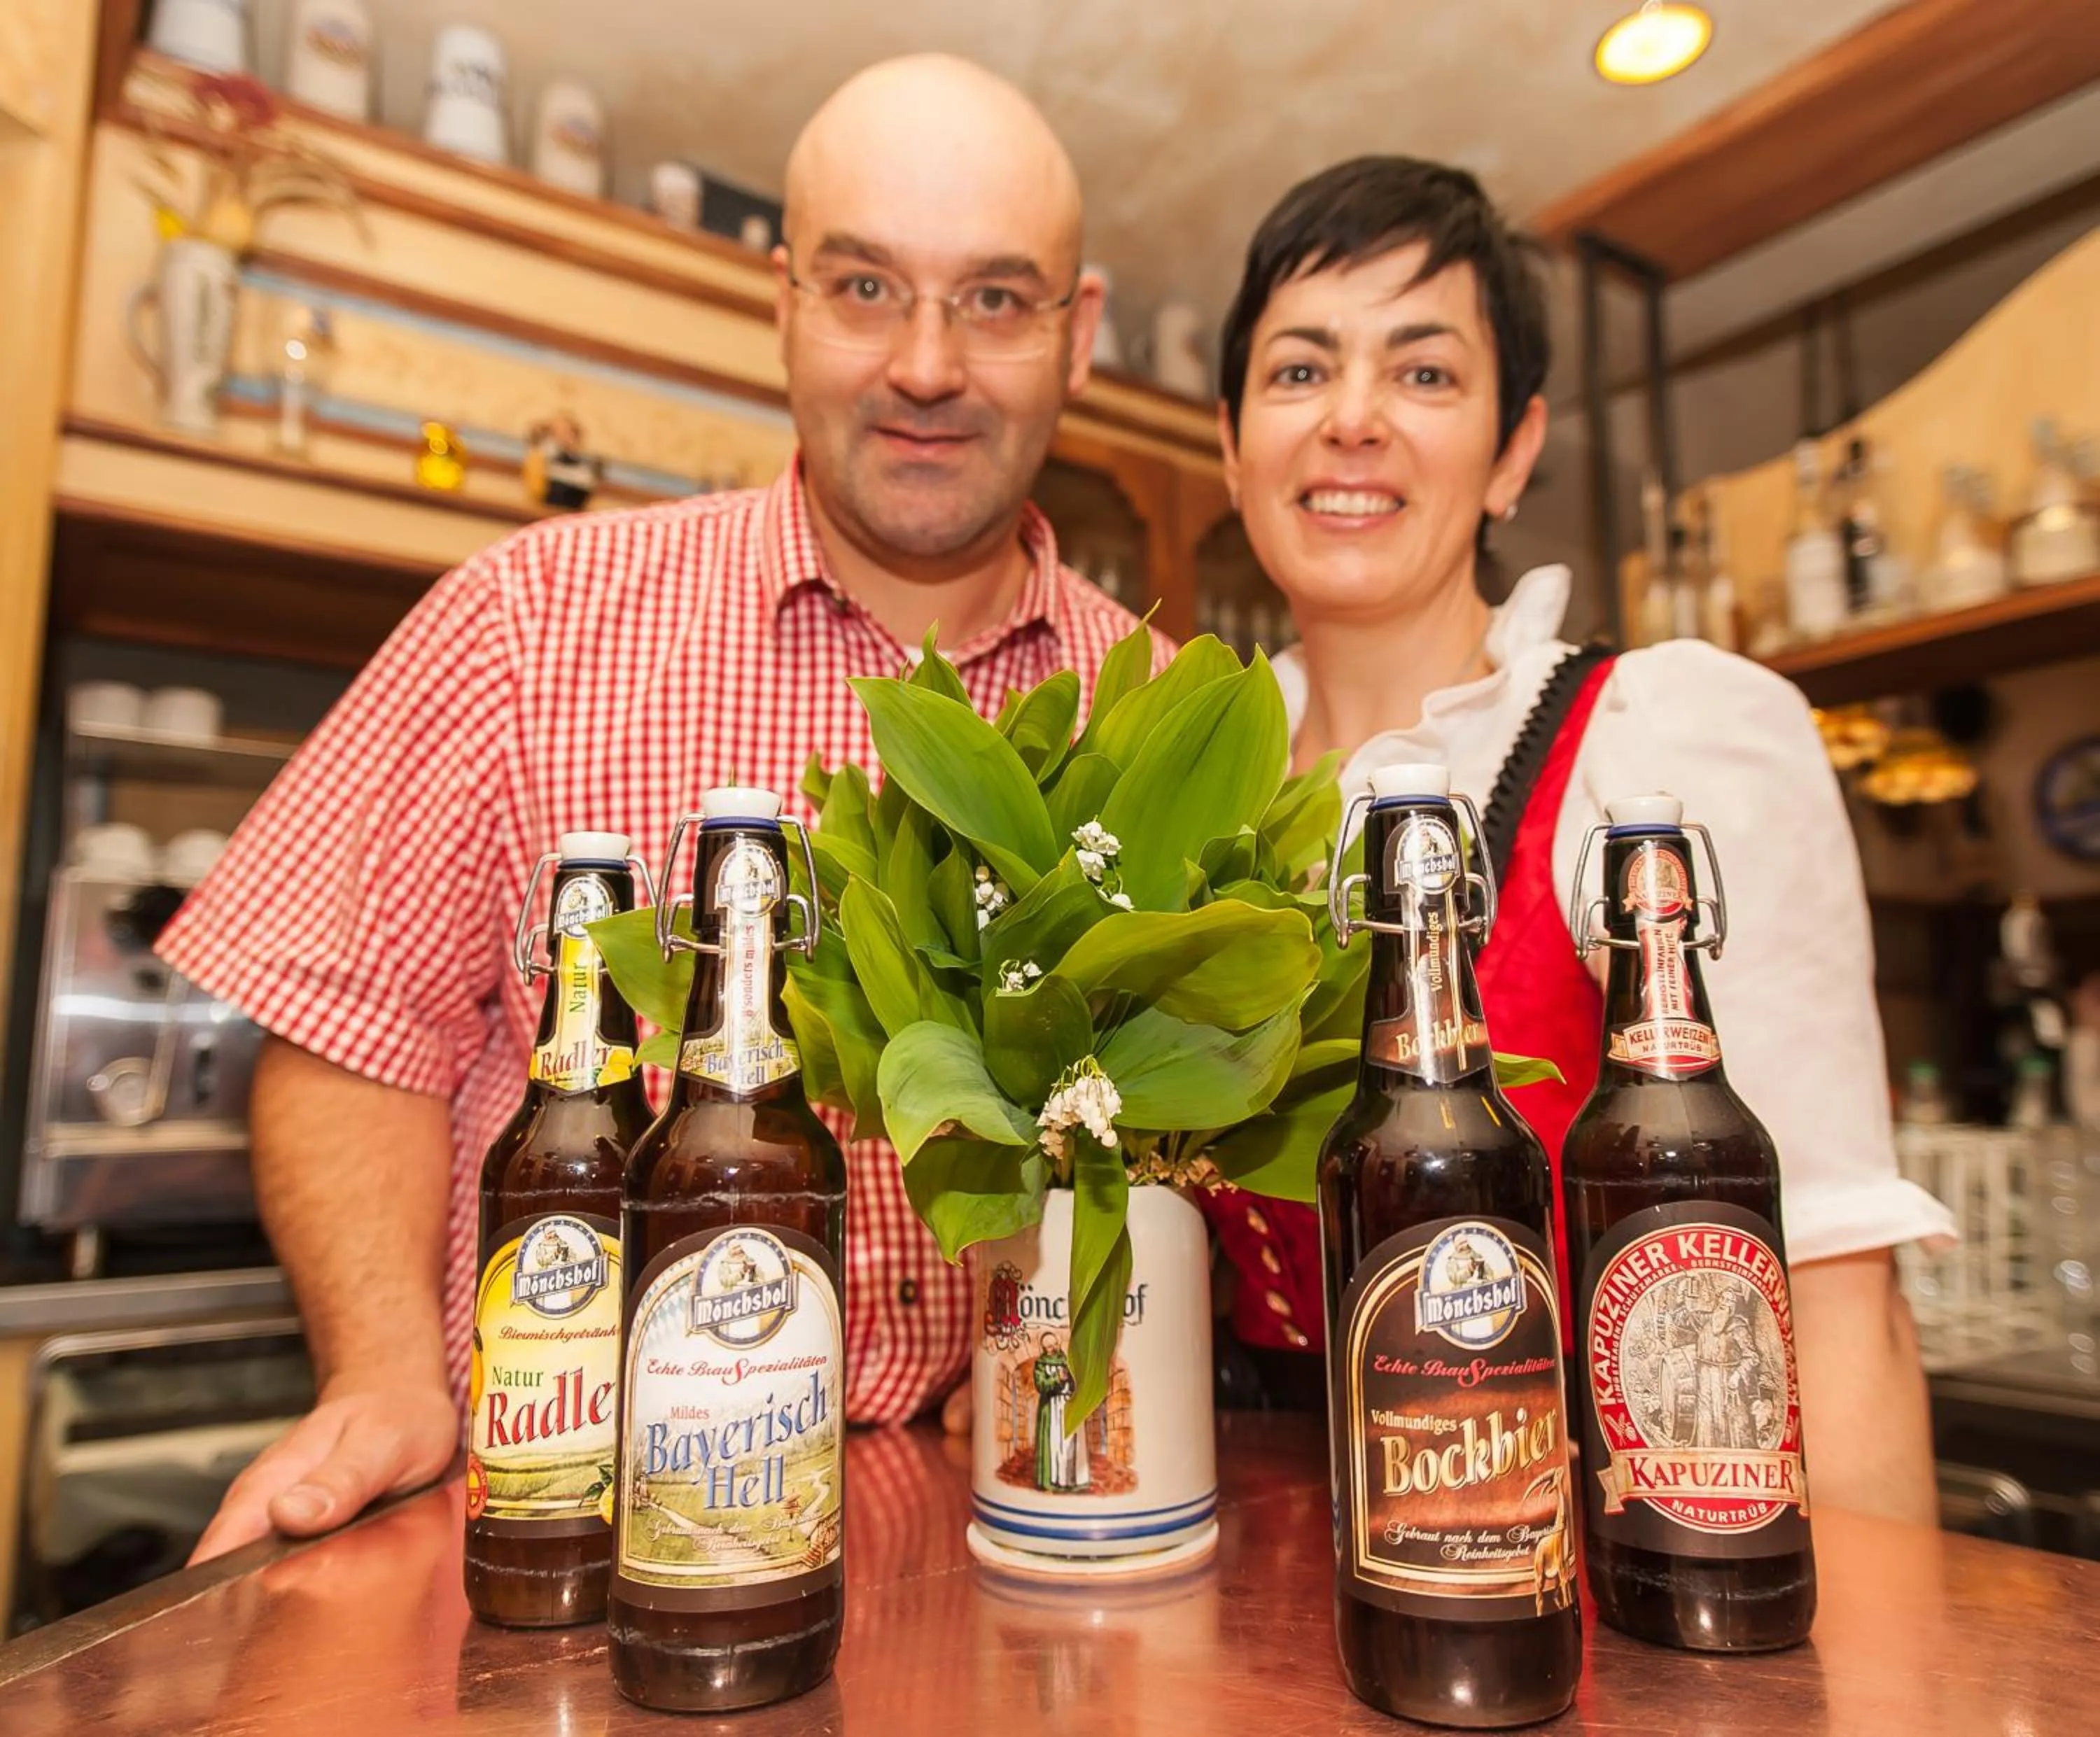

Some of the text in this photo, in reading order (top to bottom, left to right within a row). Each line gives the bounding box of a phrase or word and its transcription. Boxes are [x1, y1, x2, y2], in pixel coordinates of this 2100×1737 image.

[569, 963, 588, 1013] Natur
[1629, 1027, 1710, 1045] KELLRWEIZEN
[1642, 1041, 1702, 1053] NAURTRÜB
[519, 1260, 598, 1297] Mönchshof
[698, 1279, 788, 1325] Mönchshof
[986, 1263, 1149, 1338] Möncof
[1427, 1278, 1516, 1323] Mönchshof
[499, 1324, 620, 1344] Biermischgetränk
[1592, 1242, 1669, 1406] KAPUZINER
[492, 1365, 544, 1386] Natur
[646, 1358, 684, 1376] Echte
[1374, 1354, 1418, 1375] Echte
[485, 1366, 616, 1449] Radle
[670, 1406, 710, 1421] Mildes
[1371, 1409, 1458, 1435] Vollmundiges
[645, 1369, 828, 1485] Bayerisch
[1380, 1407, 1558, 1496] Bockbier
[704, 1454, 785, 1510] Hell
[1628, 1456, 1795, 1493] KAPUZINER
[1671, 1499, 1768, 1524] NATURTRÜB
[1384, 1519, 1441, 1545] Gebraut
[1444, 1529, 1473, 1544] nach
[1477, 1529, 1502, 1543] dem
[1440, 1542, 1530, 1562] Reinheitsgebot
